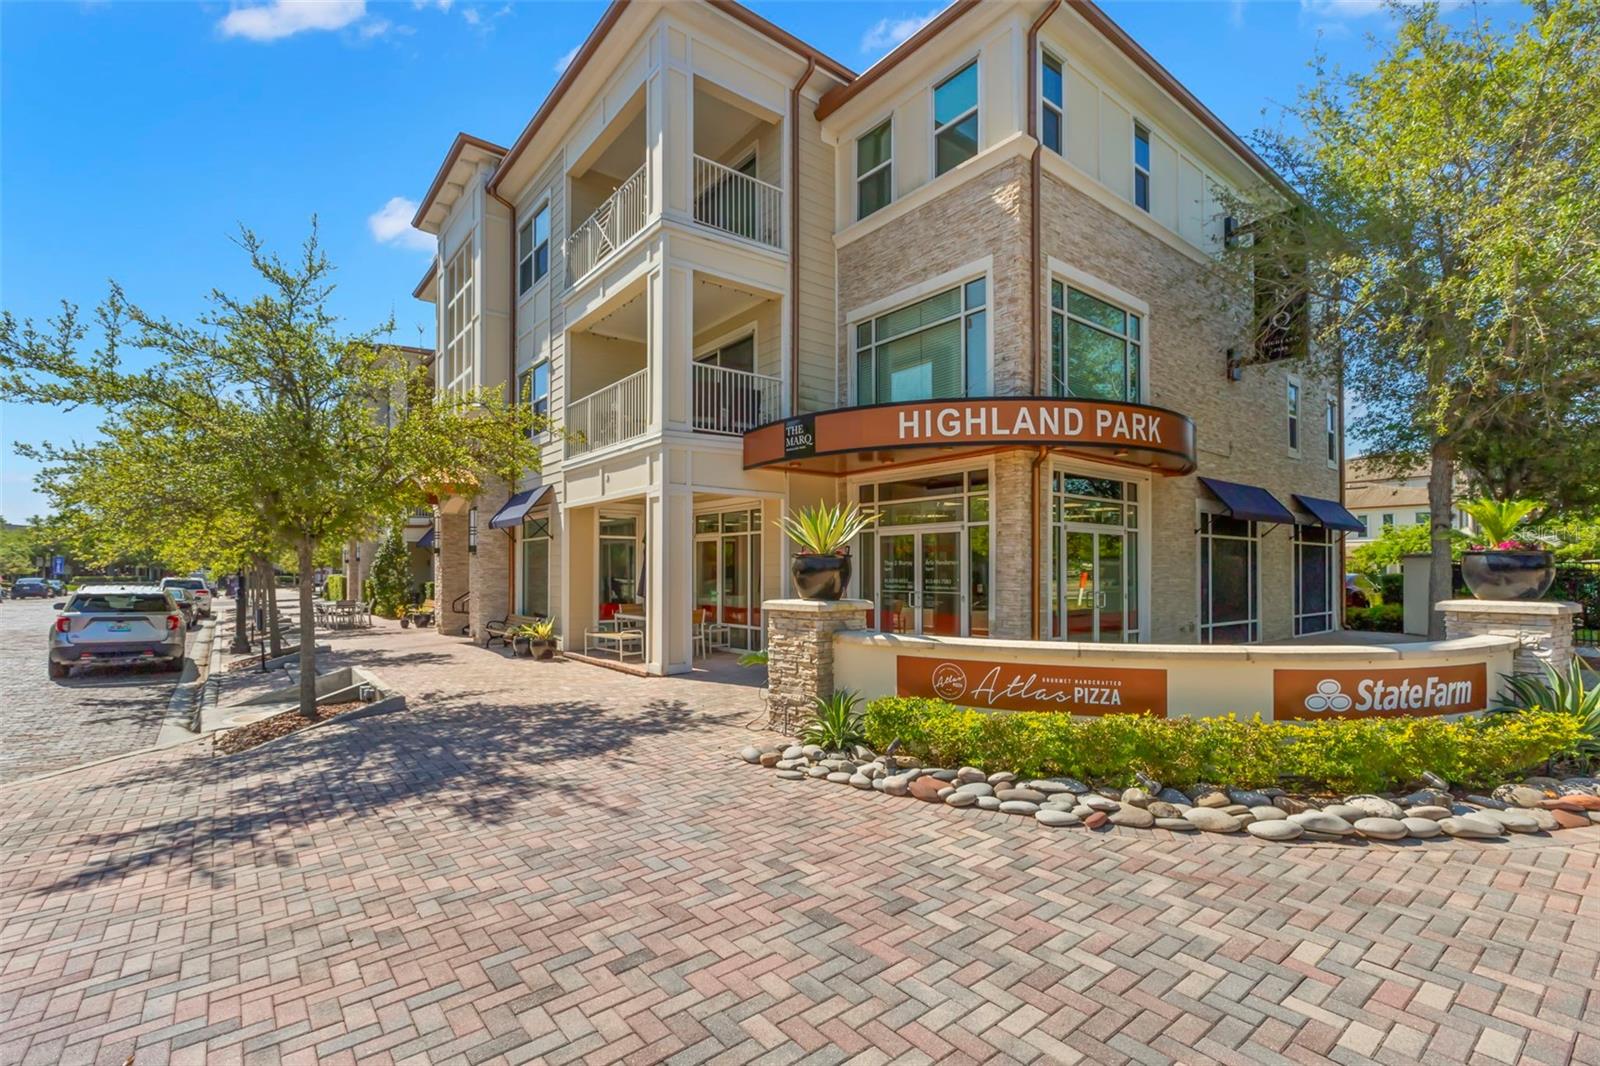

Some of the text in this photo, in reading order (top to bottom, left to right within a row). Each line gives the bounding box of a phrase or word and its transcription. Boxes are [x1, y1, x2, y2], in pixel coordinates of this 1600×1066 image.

[785, 424, 804, 437] THE
[898, 406, 1161, 443] HIGHLAND PARK
[785, 433, 813, 448] MARQ
[971, 666, 1121, 705] Atlas PIZZA
